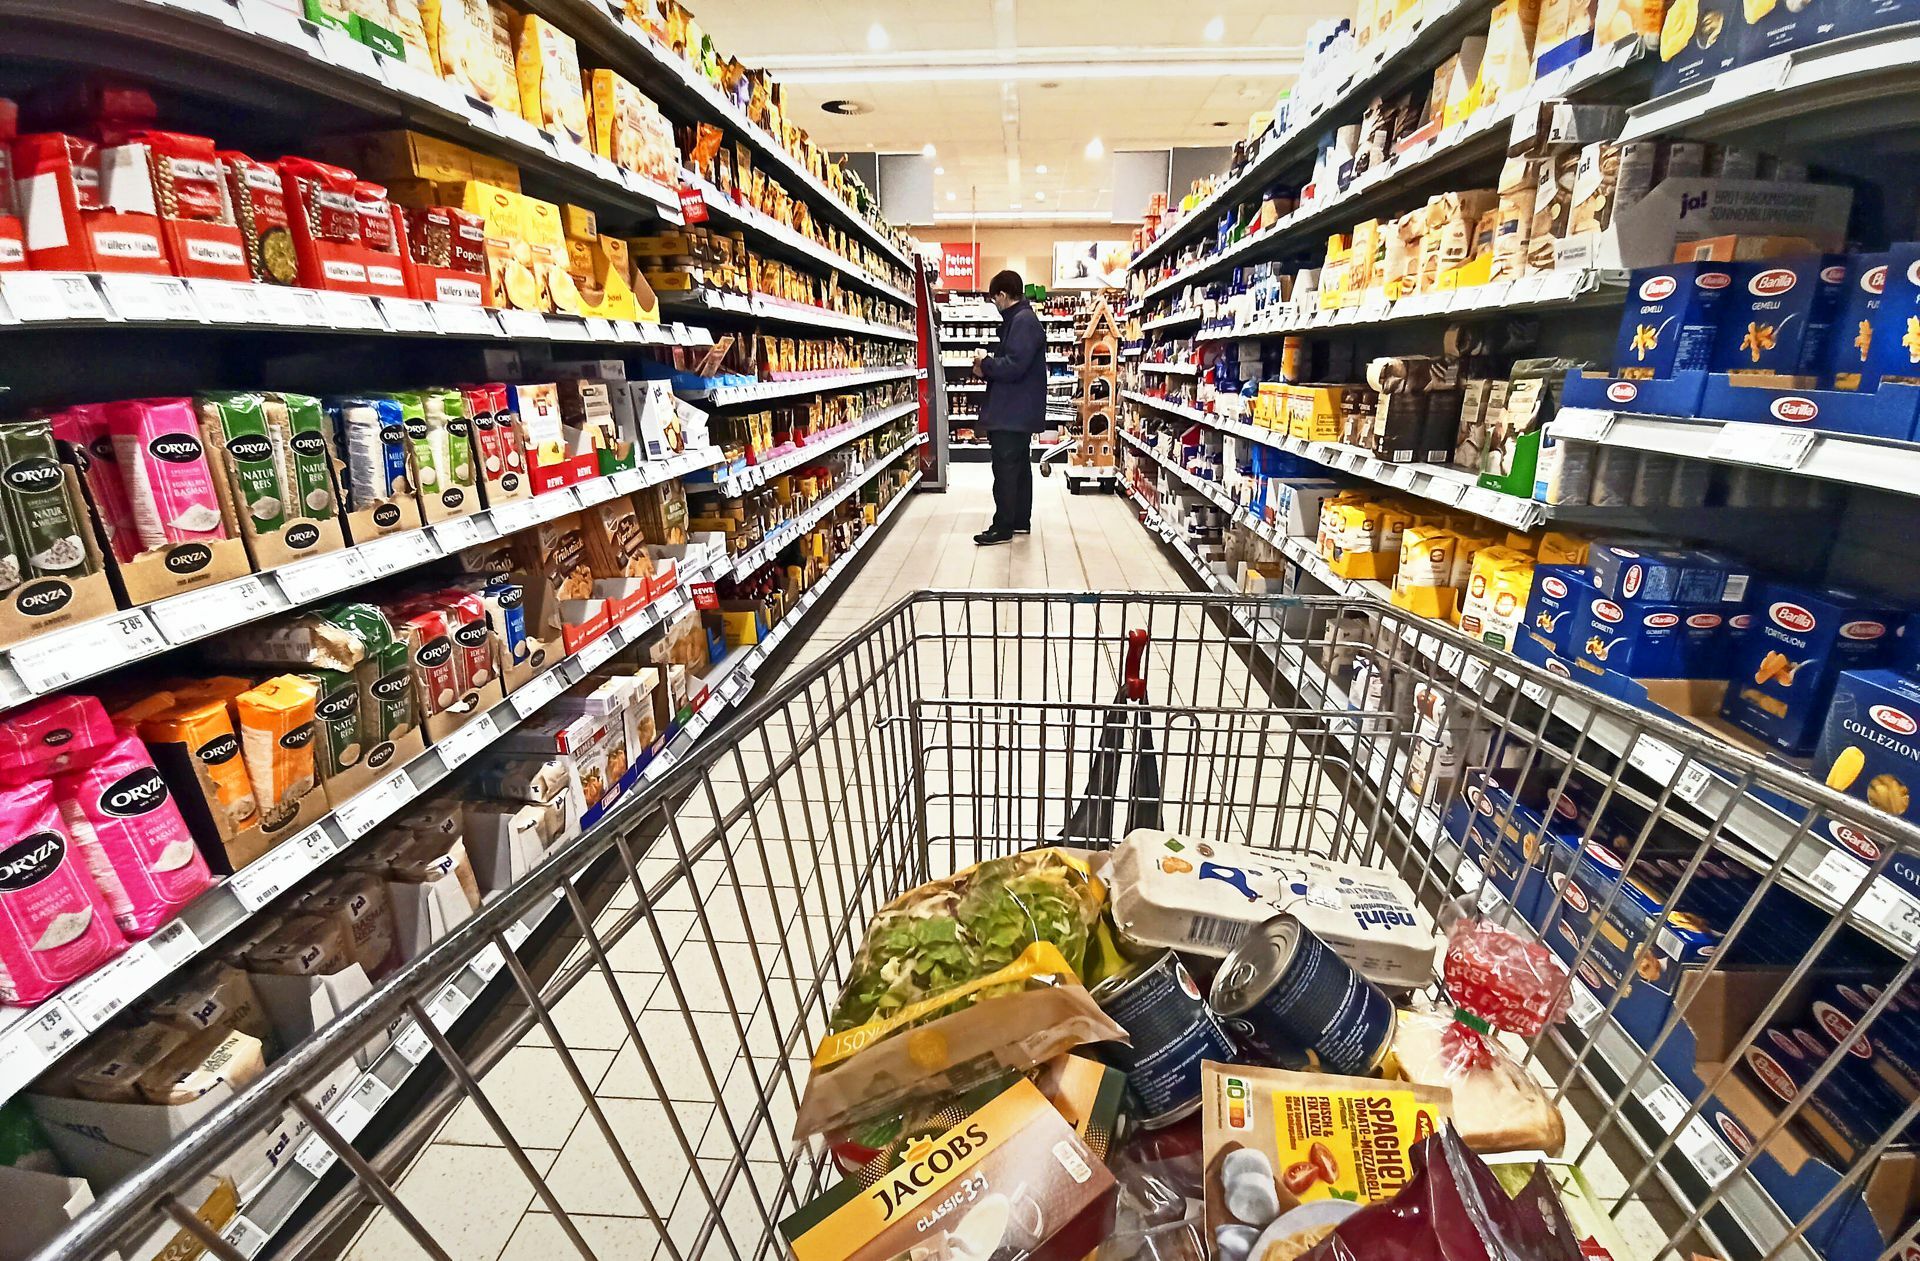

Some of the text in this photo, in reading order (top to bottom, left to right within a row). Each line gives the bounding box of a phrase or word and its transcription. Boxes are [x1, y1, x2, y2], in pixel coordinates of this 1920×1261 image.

[1577, 157, 1591, 182] ja!
[1679, 190, 1708, 220] ja!
[945, 254, 973, 265] Feine
[945, 265, 973, 277] leben
[1757, 274, 1792, 290] Barilla
[1640, 304, 1663, 315] GEMELLI
[1751, 300, 1781, 311] GEMELLI
[1780, 401, 1815, 417] Barilla
[156, 442, 200, 454] ORYZA
[232, 441, 271, 455] ORYZA
[11, 465, 59, 483] ORYZA
[242, 468, 275, 482] NATUR
[252, 478, 272, 490] REIS
[443, 494, 463, 502] ORYZA
[33, 506, 63, 519] NATUR
[376, 509, 398, 521] ORYZA
[288, 529, 317, 542] ORYZA
[170, 551, 208, 566] ORYZA
[21, 588, 68, 608] ORYZA
[1596, 603, 1621, 619] Barilla
[1651, 616, 1676, 625] Barilla
[1777, 607, 1812, 629] Barilla
[1763, 625, 1807, 649] TORTIGLIONI
[422, 643, 451, 661] ORYZA
[1878, 708, 1914, 733] Barilla
[200, 739, 238, 761] ORYZA
[1842, 717, 1920, 762] COLLEZION
[369, 746, 393, 763] ORYZA
[110, 775, 165, 808] ORYZA
[1839, 826, 1877, 858] Barilla
[0, 839, 60, 881] ORYZA
[1353, 910, 1417, 931] nein!
[300, 946, 320, 969] ja!
[193, 1001, 218, 1026] ja!
[202, 1036, 240, 1071] JASMIN
[1755, 1056, 1796, 1098] Barilla
[265, 1083, 338, 1168] ja! REIS
[1306, 1095, 1322, 1137] FIX DAZU
[1318, 1095, 1334, 1138] FRISCH &
[1353, 1097, 1382, 1202] TOMATE-MOZZARELL
[1366, 1096, 1407, 1198] SPAGHET
[871, 1122, 990, 1223] JACOBS
[915, 1189, 965, 1234] CLASSIC
